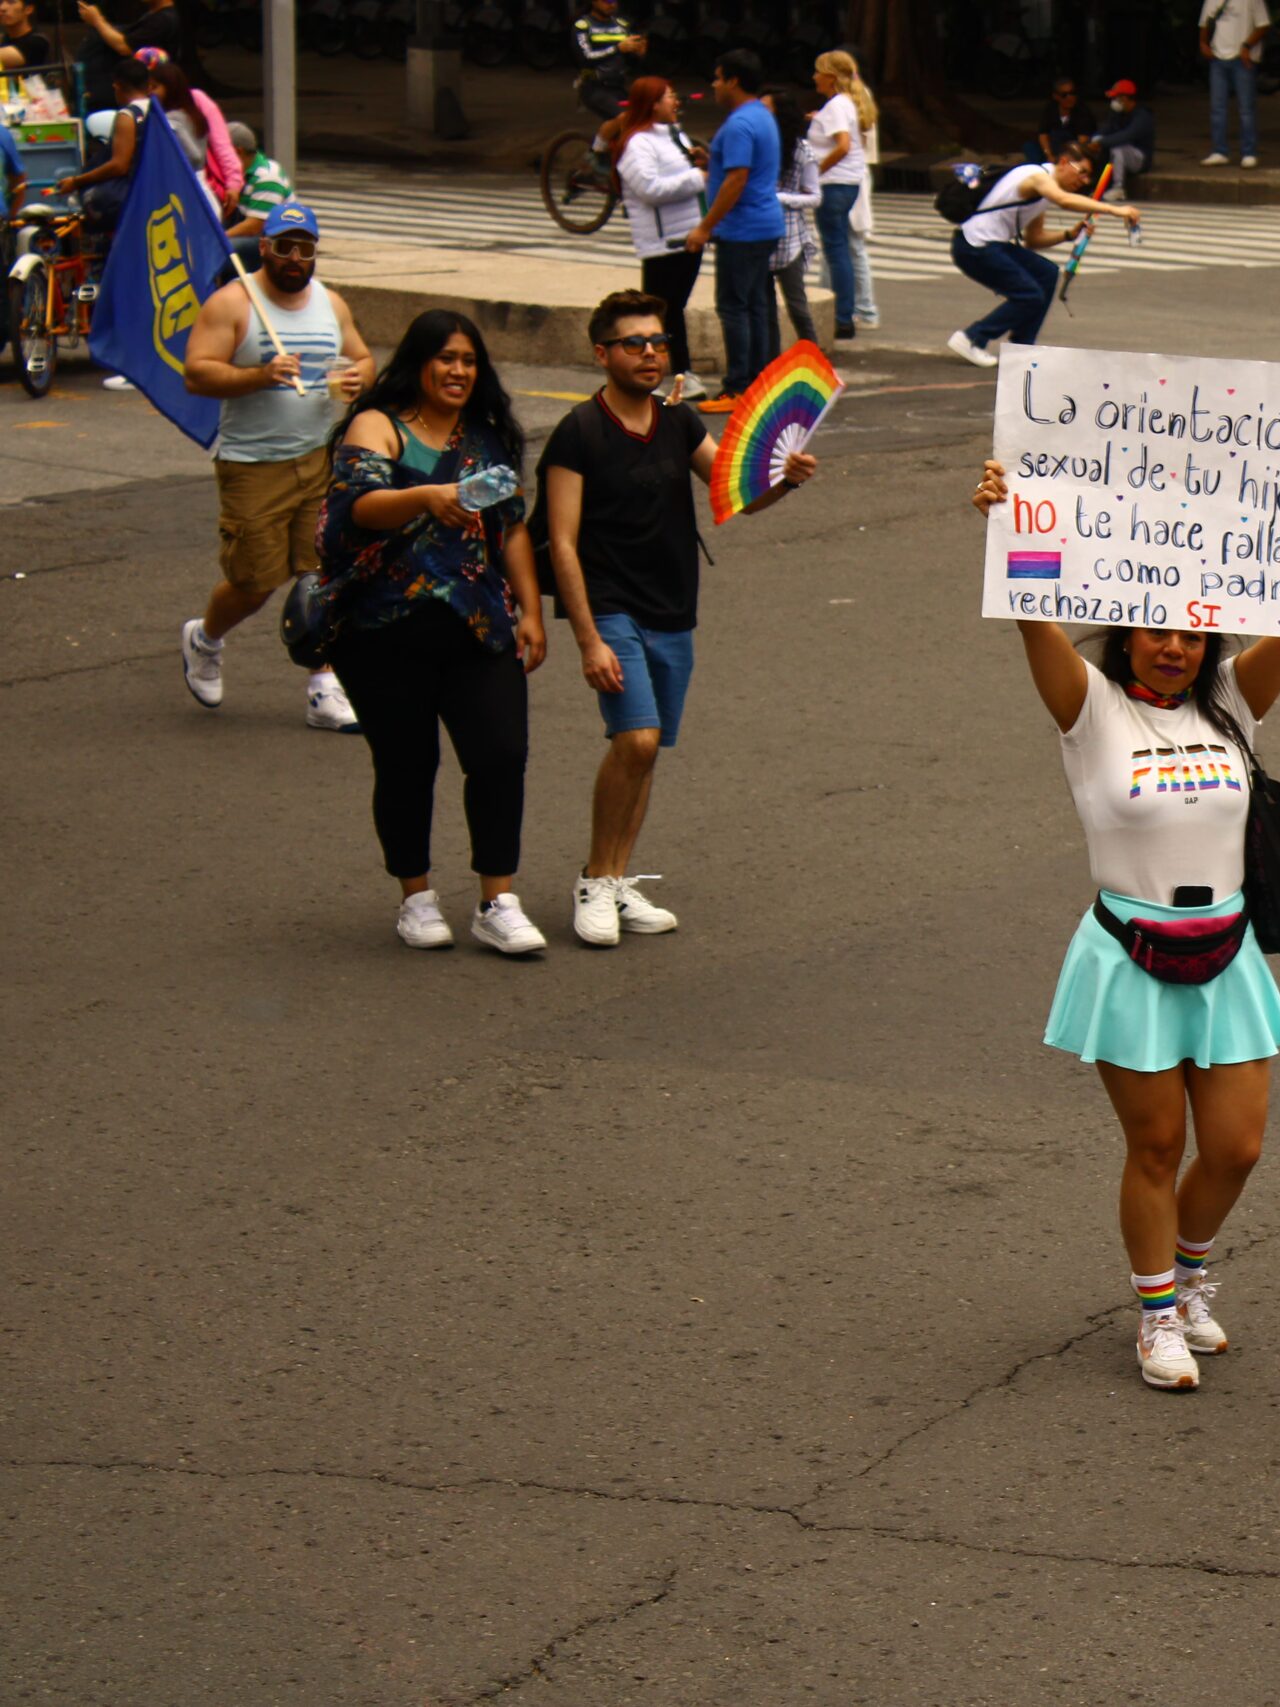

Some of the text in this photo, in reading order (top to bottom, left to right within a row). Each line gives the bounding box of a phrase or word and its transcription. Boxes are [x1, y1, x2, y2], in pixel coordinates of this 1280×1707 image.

[1023, 370, 1076, 424] La
[1018, 441, 1111, 485] sexual
[1127, 443, 1165, 491] de
[1185, 453, 1220, 495] tu
[1075, 495, 1112, 539] te
[1130, 503, 1203, 551] hace
[1094, 558, 1181, 587] como
[1009, 582, 1221, 628] rechazarlo SI
[1129, 743, 1242, 799] PRIDE
[1184, 796, 1199, 805] GAP
